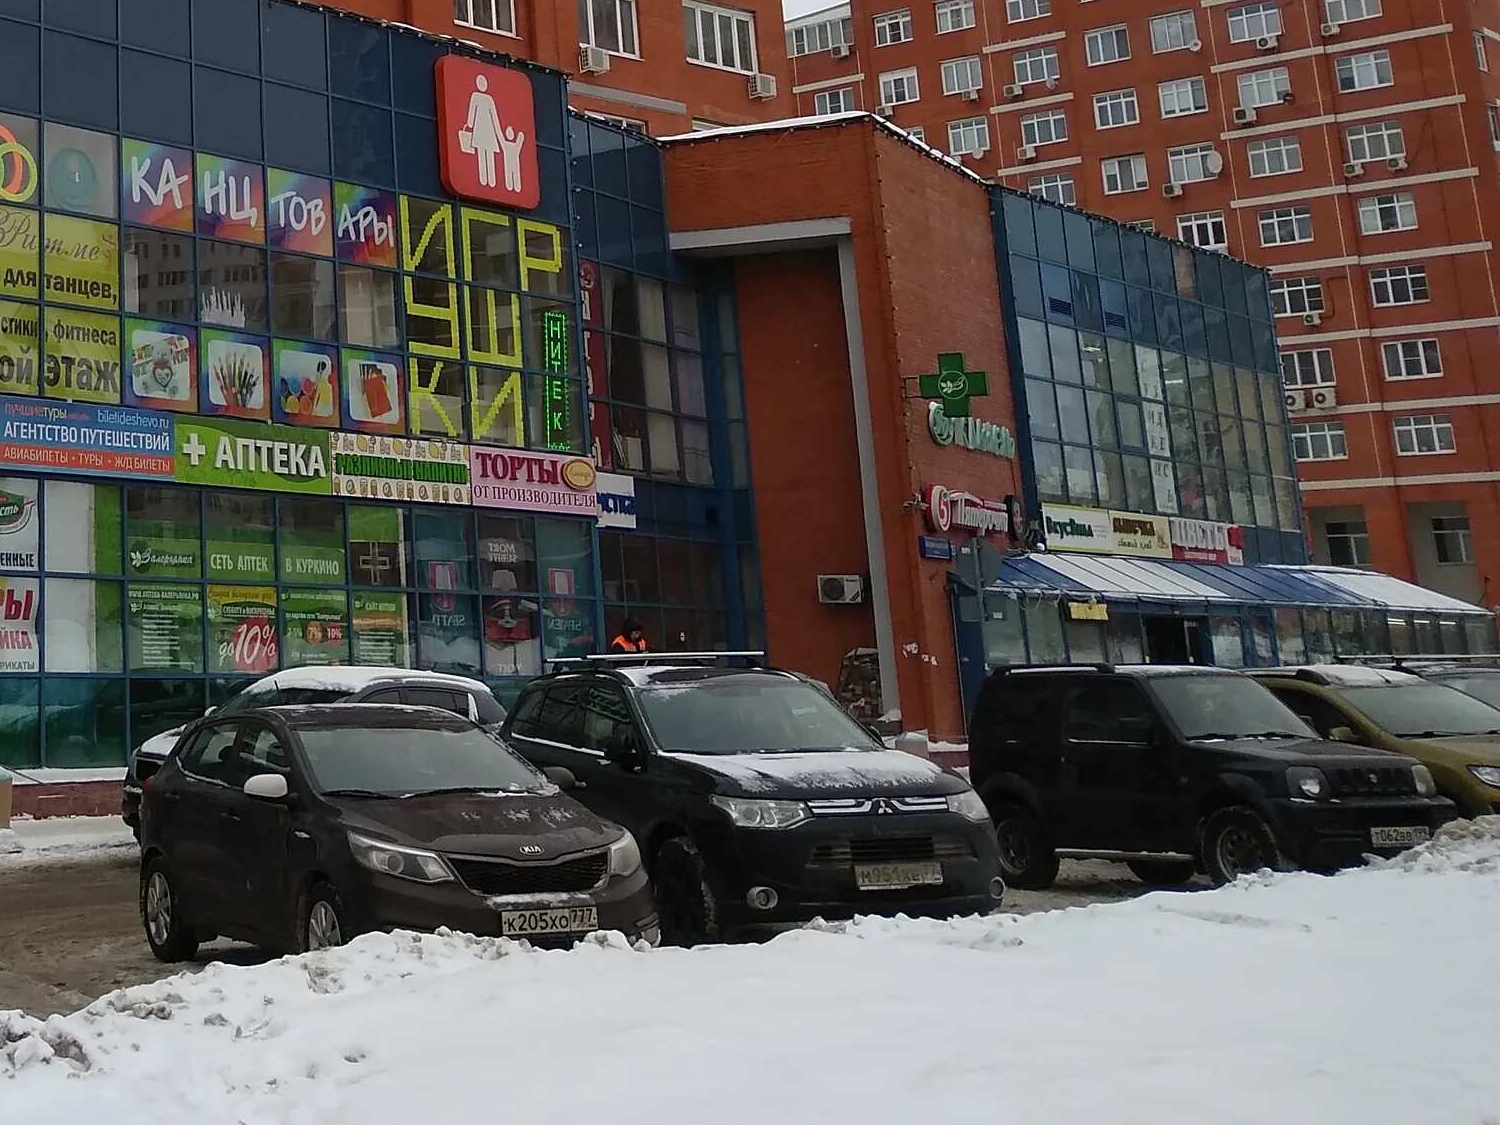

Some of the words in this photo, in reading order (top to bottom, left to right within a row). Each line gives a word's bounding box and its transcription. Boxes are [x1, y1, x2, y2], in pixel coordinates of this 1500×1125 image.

[3, 267, 38, 288] для
[53, 318, 117, 347] фитнеса
[44, 355, 120, 395] этаж
[97, 409, 169, 429] biletideshevo.ru
[4, 421, 78, 444] АГЕНТСТВО
[80, 430, 170, 451] ПУТЕШЕСТВИЙ
[4, 447, 69, 463] АВИАБИЛЕТЫ
[78, 452, 103, 466] ТУРЫ
[114, 456, 133, 470] Ж/Д
[134, 457, 170, 472] БИЛЕТЫ
[216, 436, 326, 477] АПТЕКА
[475, 452, 560, 485] ТОРТЫ
[473, 484, 490, 499] ОТ
[492, 486, 597, 508] ПРОИЗВОДИТЕЛЯ
[210, 553, 234, 570] СЕТЬ
[237, 554, 269, 572] АПТЕК
[285, 558, 293, 573] В
[296, 558, 340, 575] КУРКИНО
[234, 623, 277, 665] 10%
[327, 627, 342, 639] 10%
[523, 845, 542, 853] KIA
